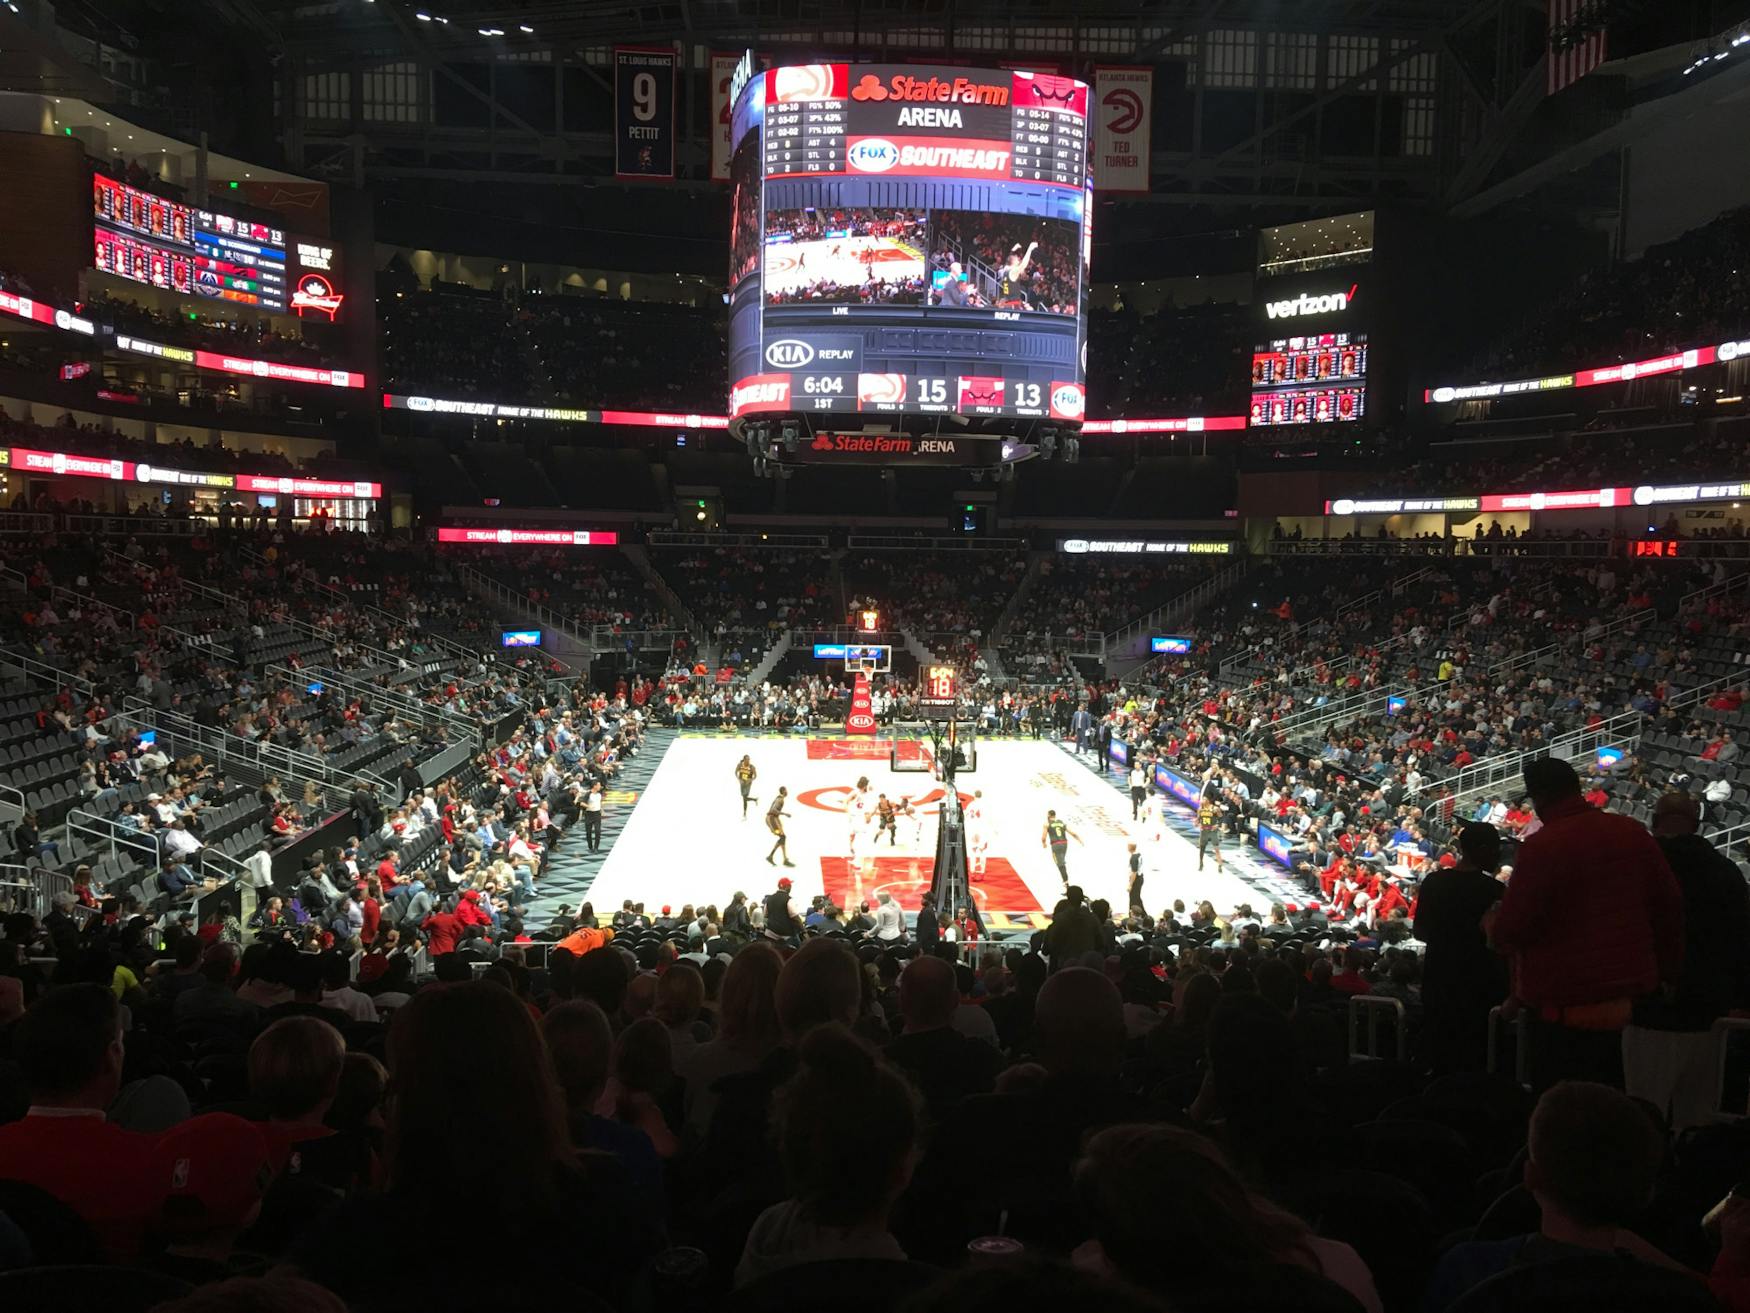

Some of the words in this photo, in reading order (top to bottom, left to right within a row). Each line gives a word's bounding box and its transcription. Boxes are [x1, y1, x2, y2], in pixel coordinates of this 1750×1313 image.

[633, 72, 656, 121] 9
[898, 107, 963, 128] ARENA
[628, 126, 659, 140] PETTIT
[829, 138, 835, 146] 4
[1114, 142, 1130, 153] TED
[859, 147, 886, 158] FOX
[900, 146, 1010, 171] SOUTHEAST
[1105, 156, 1138, 167] TURNER
[237, 222, 249, 233] 15
[272, 230, 282, 241] 13
[321, 248, 332, 259] OF
[833, 307, 849, 315] LIVE
[1266, 293, 1346, 319] verizon
[994, 312, 1020, 321] REPLAY
[1337, 334, 1347, 343] 13
[163, 347, 193, 361] HAWKS
[773, 346, 806, 362] KIA
[819, 350, 853, 359] REPLAY
[804, 377, 843, 393] 6:04
[1540, 376, 1572, 388] HAWKS
[917, 379, 946, 403] 15
[1015, 383, 1040, 407] 13
[814, 398, 833, 408] 1ST
[435, 400, 495, 414] SOUTHEAST
[498, 406, 519, 416] HOME
[520, 408, 530, 416] OF
[531, 409, 544, 417] THE
[545, 410, 587, 420] HAWKS
[656, 416, 685, 425] STREAM
[208, 476, 233, 486] HAWKS
[1444, 499, 1477, 509] HAWKS
[513, 533, 562, 541] EVERYWHERE
[1089, 542, 1144, 552] SOUTHEAST
[1190, 544, 1228, 552] HAWKS
[865, 618, 875, 629] 18
[933, 679, 950, 696] 18
